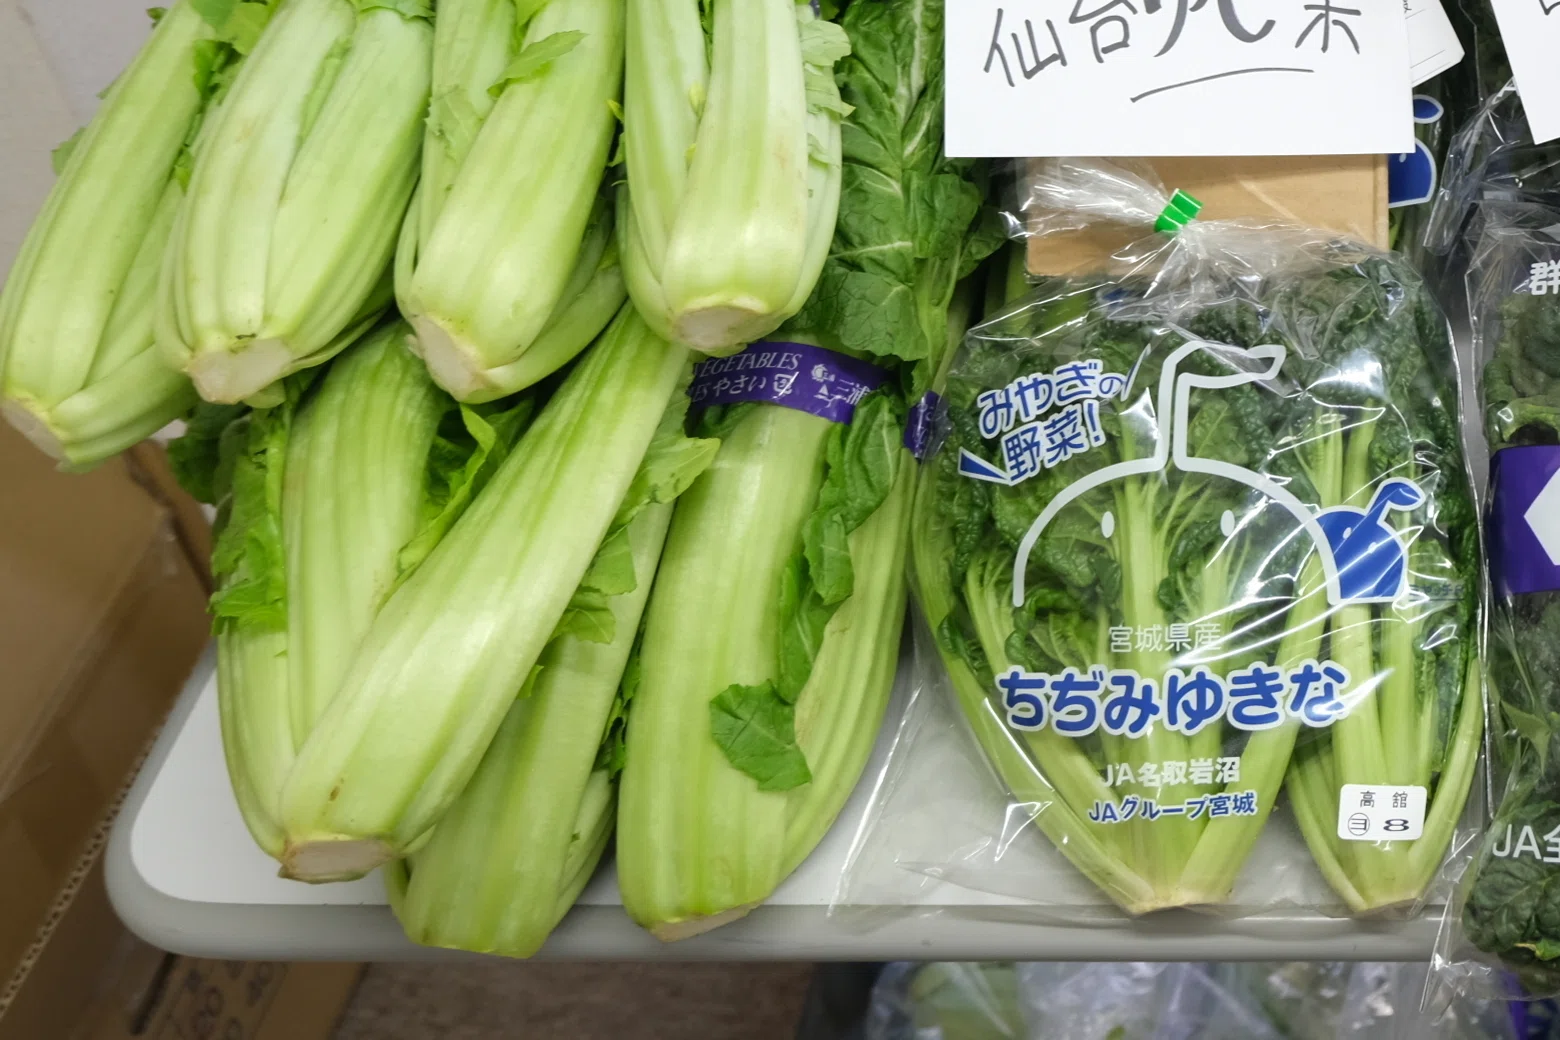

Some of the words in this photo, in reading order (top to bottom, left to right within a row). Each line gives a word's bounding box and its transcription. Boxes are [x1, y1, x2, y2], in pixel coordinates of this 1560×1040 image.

[713, 374, 767, 398] やさい
[979, 361, 1123, 436] みやぎの
[1108, 623, 1222, 654] 宮城県産
[999, 663, 1347, 735] ちぢみゆきな
[1101, 757, 1240, 788] JA名取岩沼
[1088, 791, 1258, 823] JAグループ宮城
